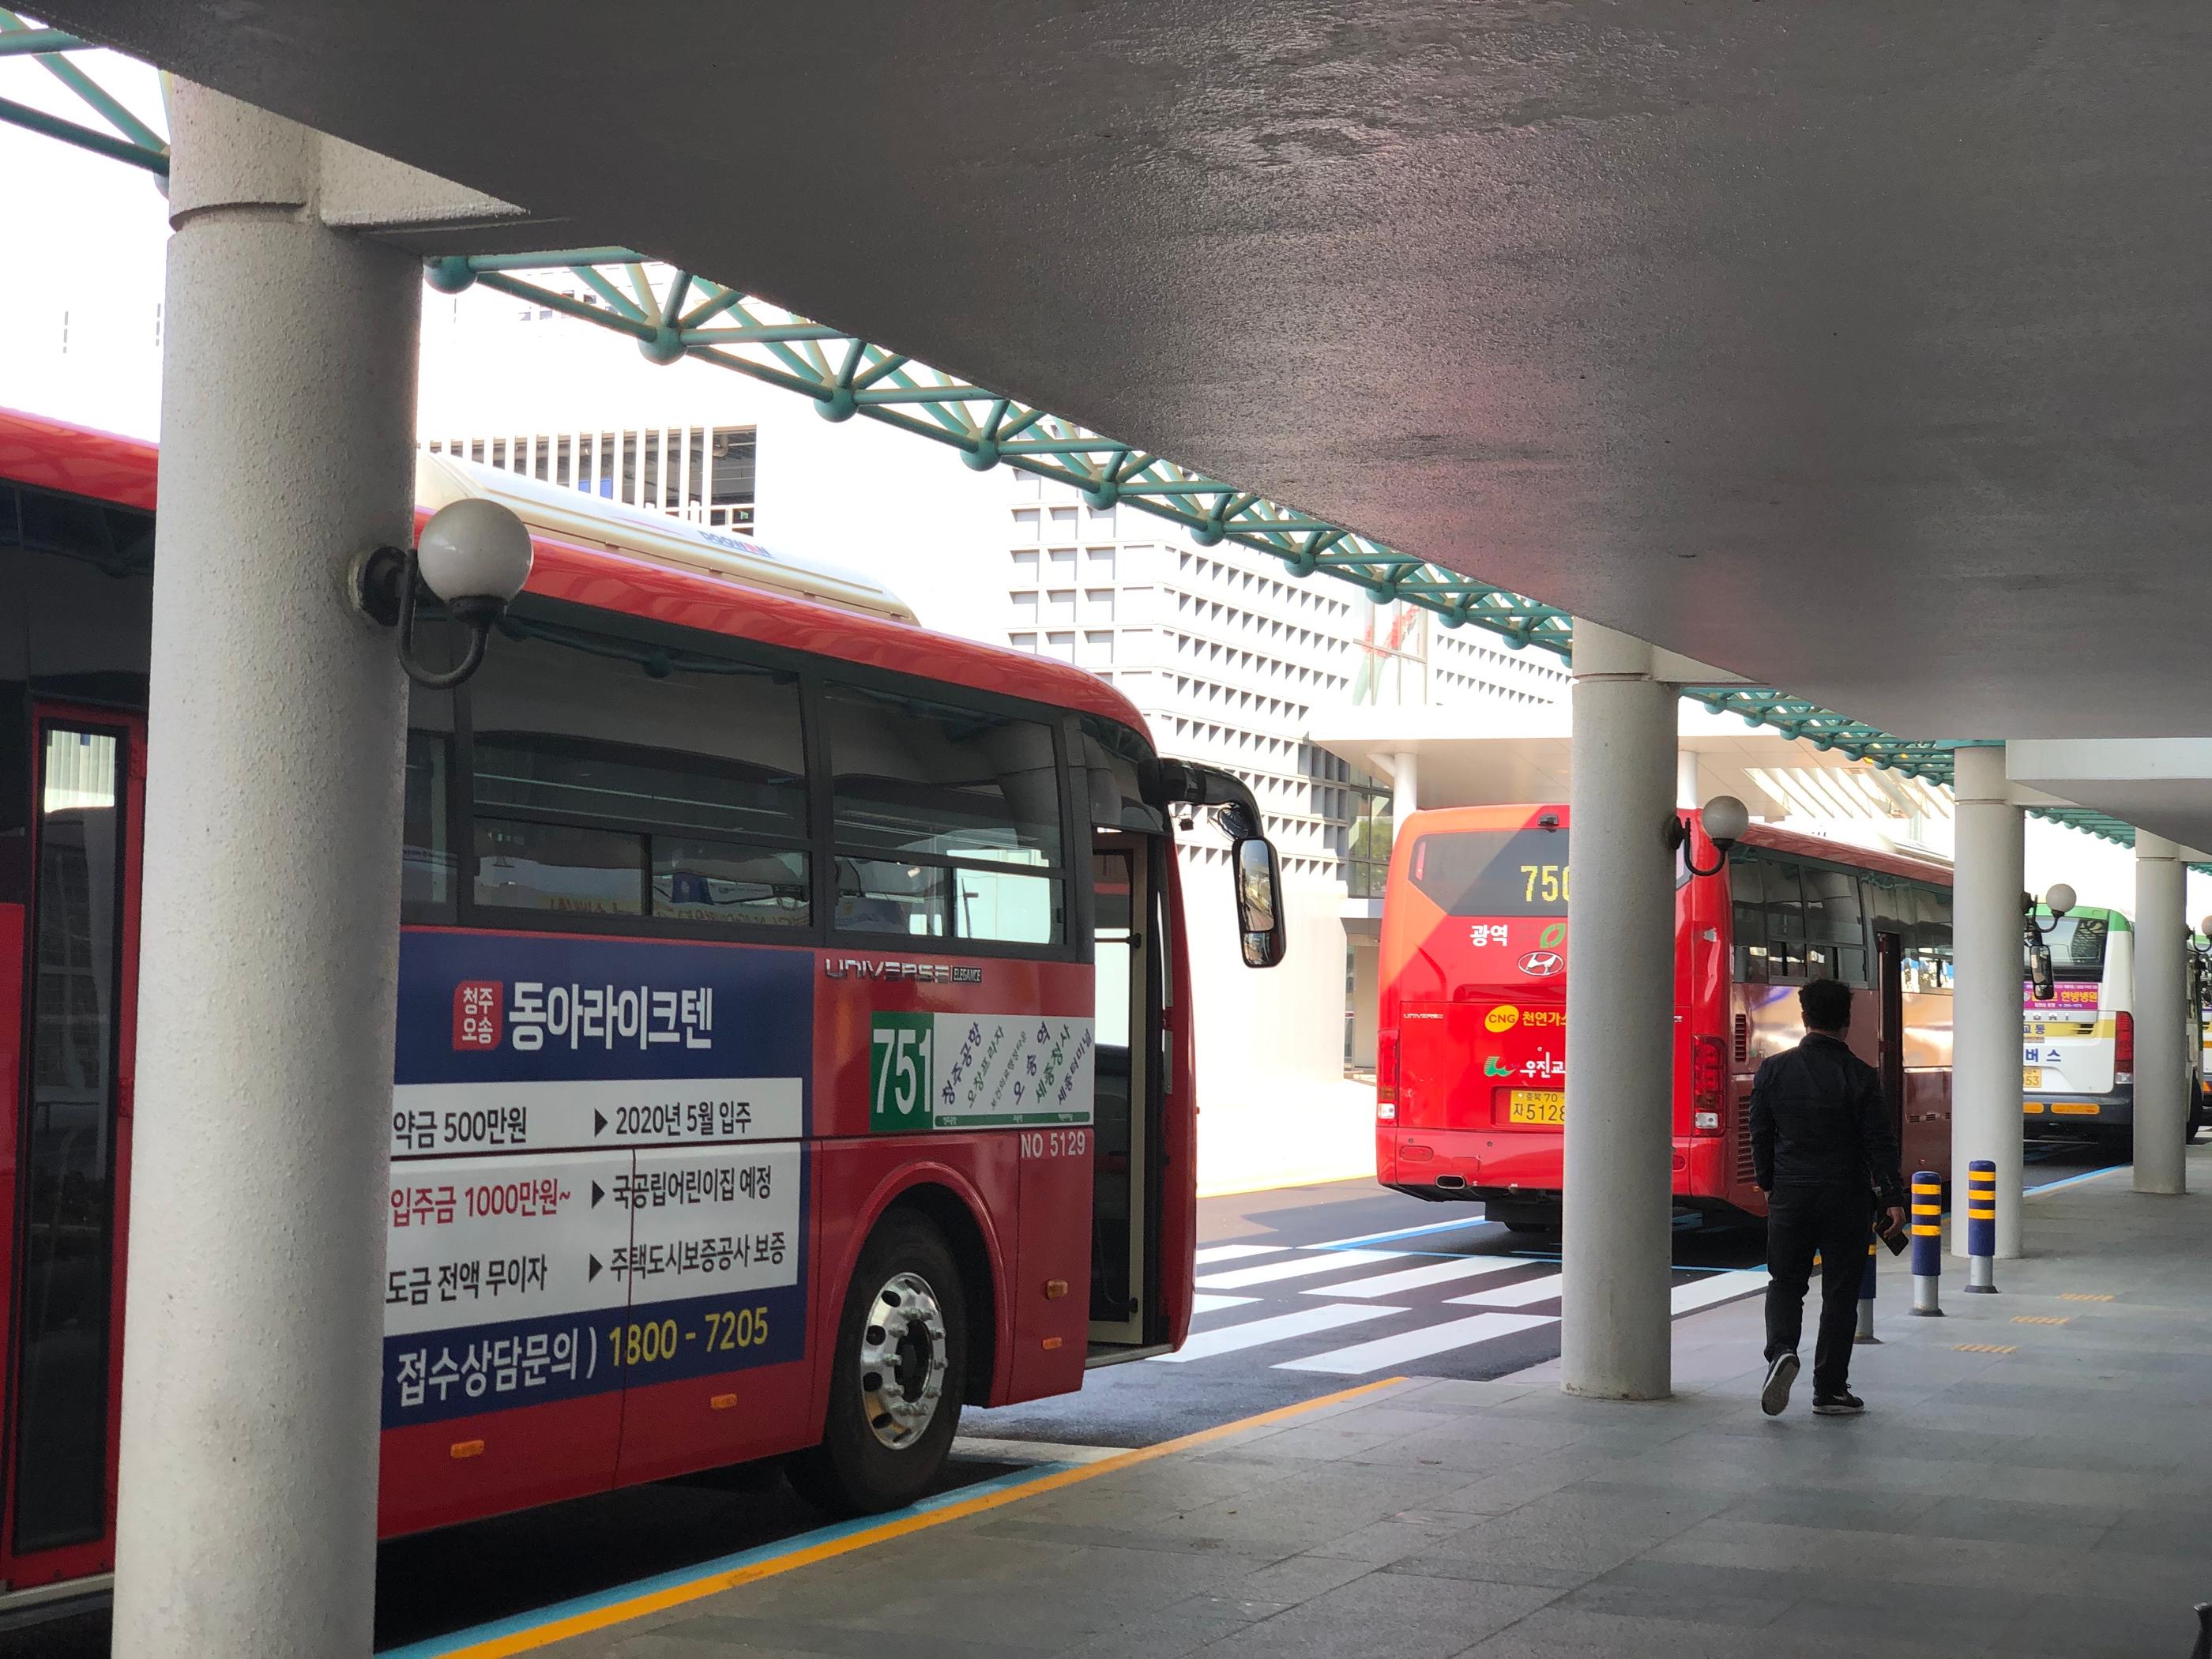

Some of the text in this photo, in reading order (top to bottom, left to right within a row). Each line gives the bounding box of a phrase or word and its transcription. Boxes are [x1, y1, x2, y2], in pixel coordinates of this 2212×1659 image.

[1470, 924, 1508, 947] 광역
[824, 958, 981, 983] UNIVERSE ELEGANCE
[463, 987, 494, 1014] 청주
[509, 982, 713, 1051] 동아라이크텐
[2061, 991, 2097, 1003] 한방병원
[462, 1018, 494, 1044] 오송
[1488, 1013, 1516, 1024] CNG
[873, 1029, 931, 1115] 751
[942, 1021, 981, 1104] 청주공항
[968, 1025, 1006, 1108] 오창프라자
[1036, 1024, 1071, 1104] 세종청사
[1058, 1028, 1093, 1105] 세종터미널
[1526, 1093, 1558, 1102] 충북 70
[444, 1107, 527, 1144] 500만원
[616, 1101, 752, 1136] 2020년 5월 입주
[1021, 1130, 1085, 1158] NO 5129
[613, 1165, 772, 1209] 국공립어린이집 예정
[390, 1187, 457, 1228] 입주금
[610, 1232, 787, 1281] 주택도시보증공사 보증
[386, 1254, 548, 1305] 도금 전액 무이자
